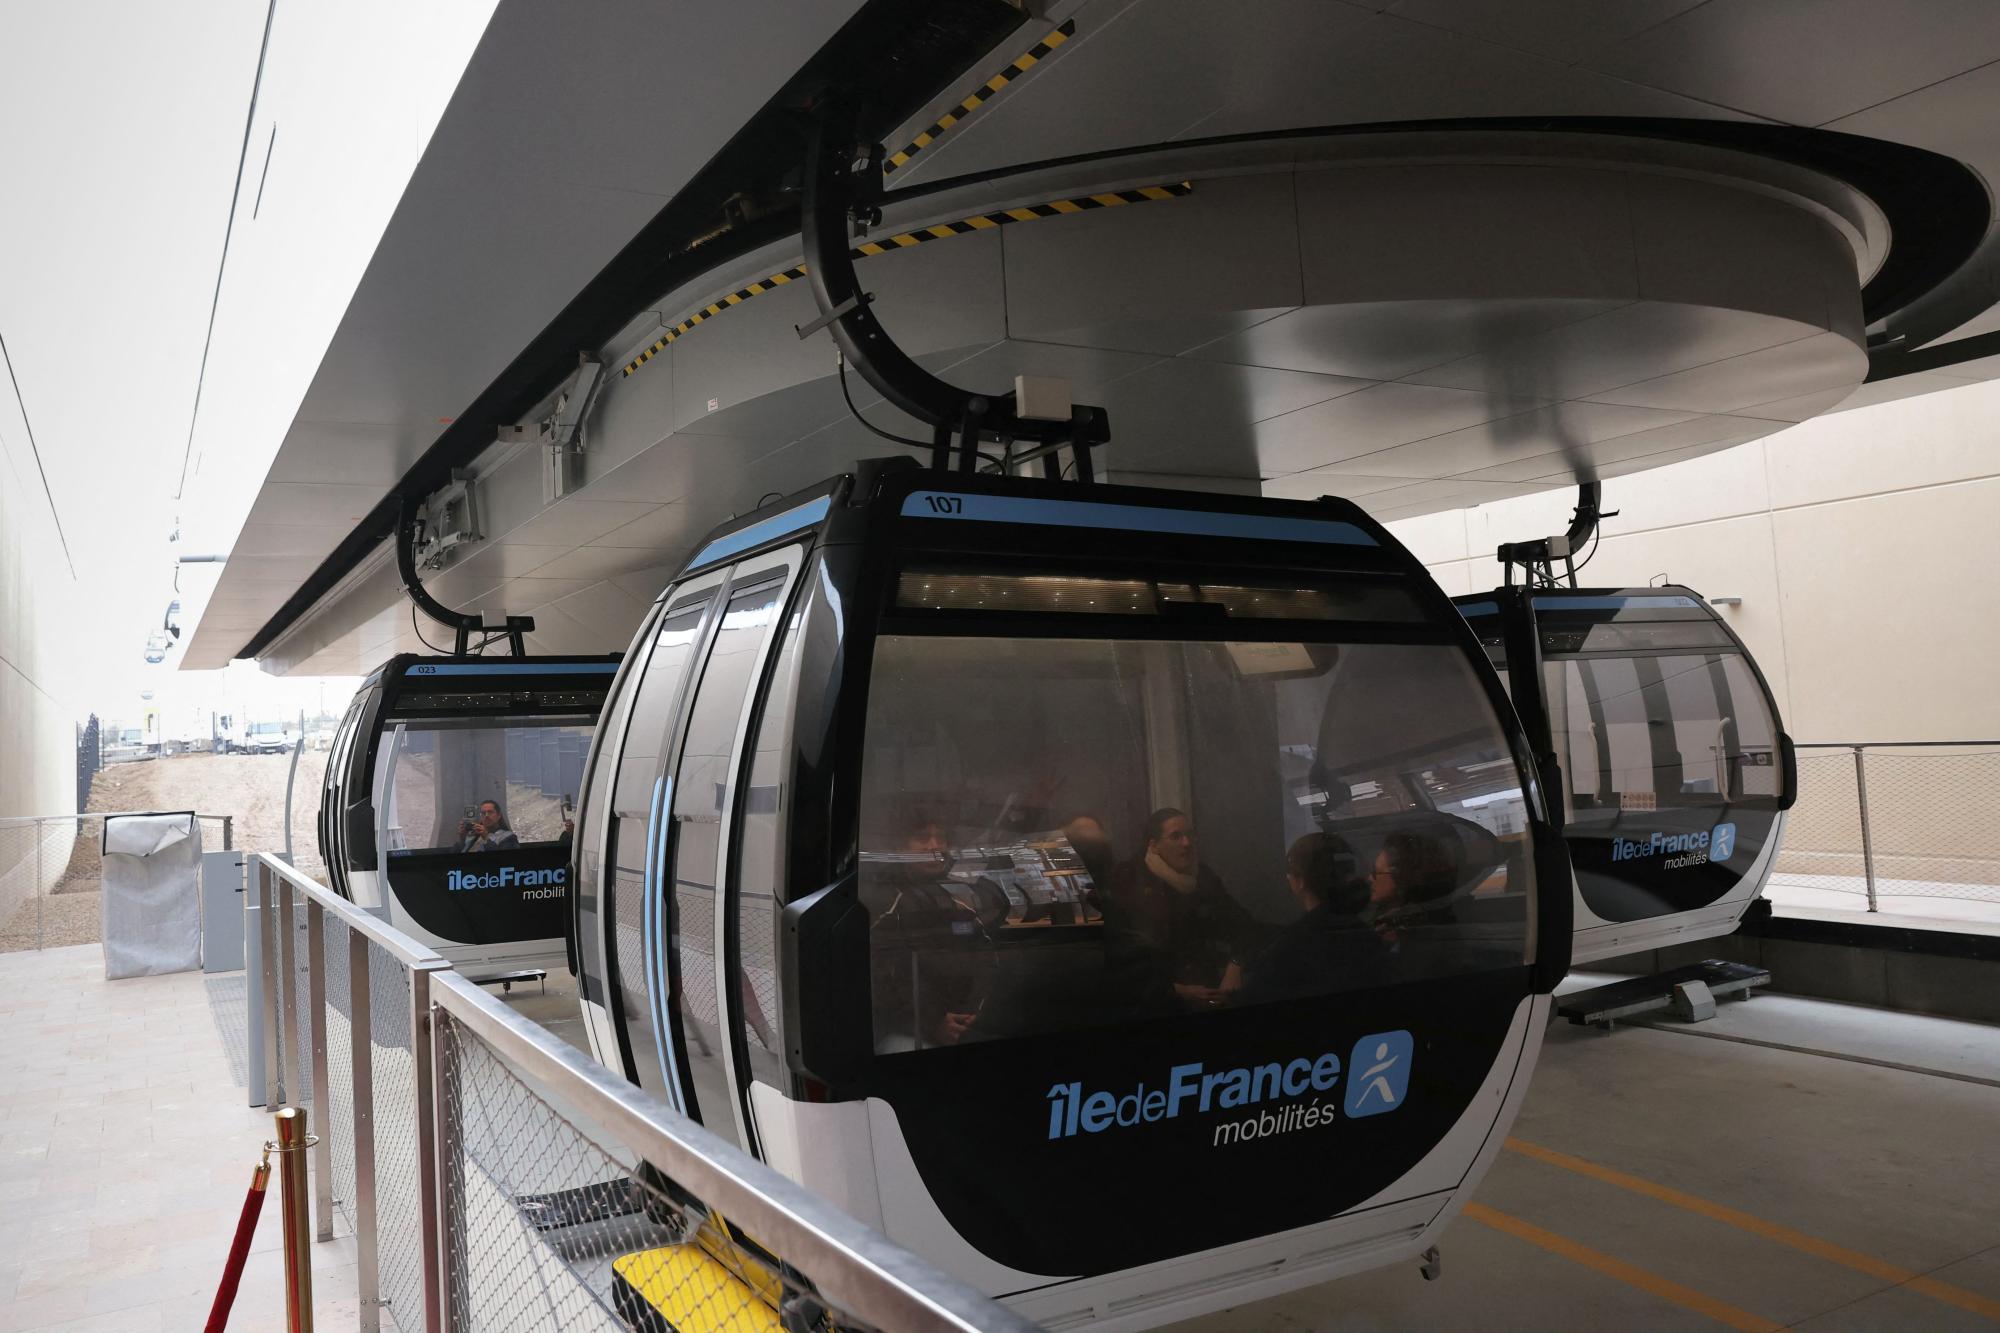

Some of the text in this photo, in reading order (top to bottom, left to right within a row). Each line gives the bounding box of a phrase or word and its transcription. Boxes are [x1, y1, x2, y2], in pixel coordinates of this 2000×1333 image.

[925, 495, 962, 514] 107
[418, 666, 436, 674] 023
[1612, 831, 1710, 862] îledeFrance
[1664, 851, 1707, 870] mobilités
[447, 867, 566, 891] îledeFranc
[523, 886, 565, 901] mobilit
[1046, 1052, 1341, 1140] îledeFrance
[1213, 1098, 1335, 1147] mobilités
